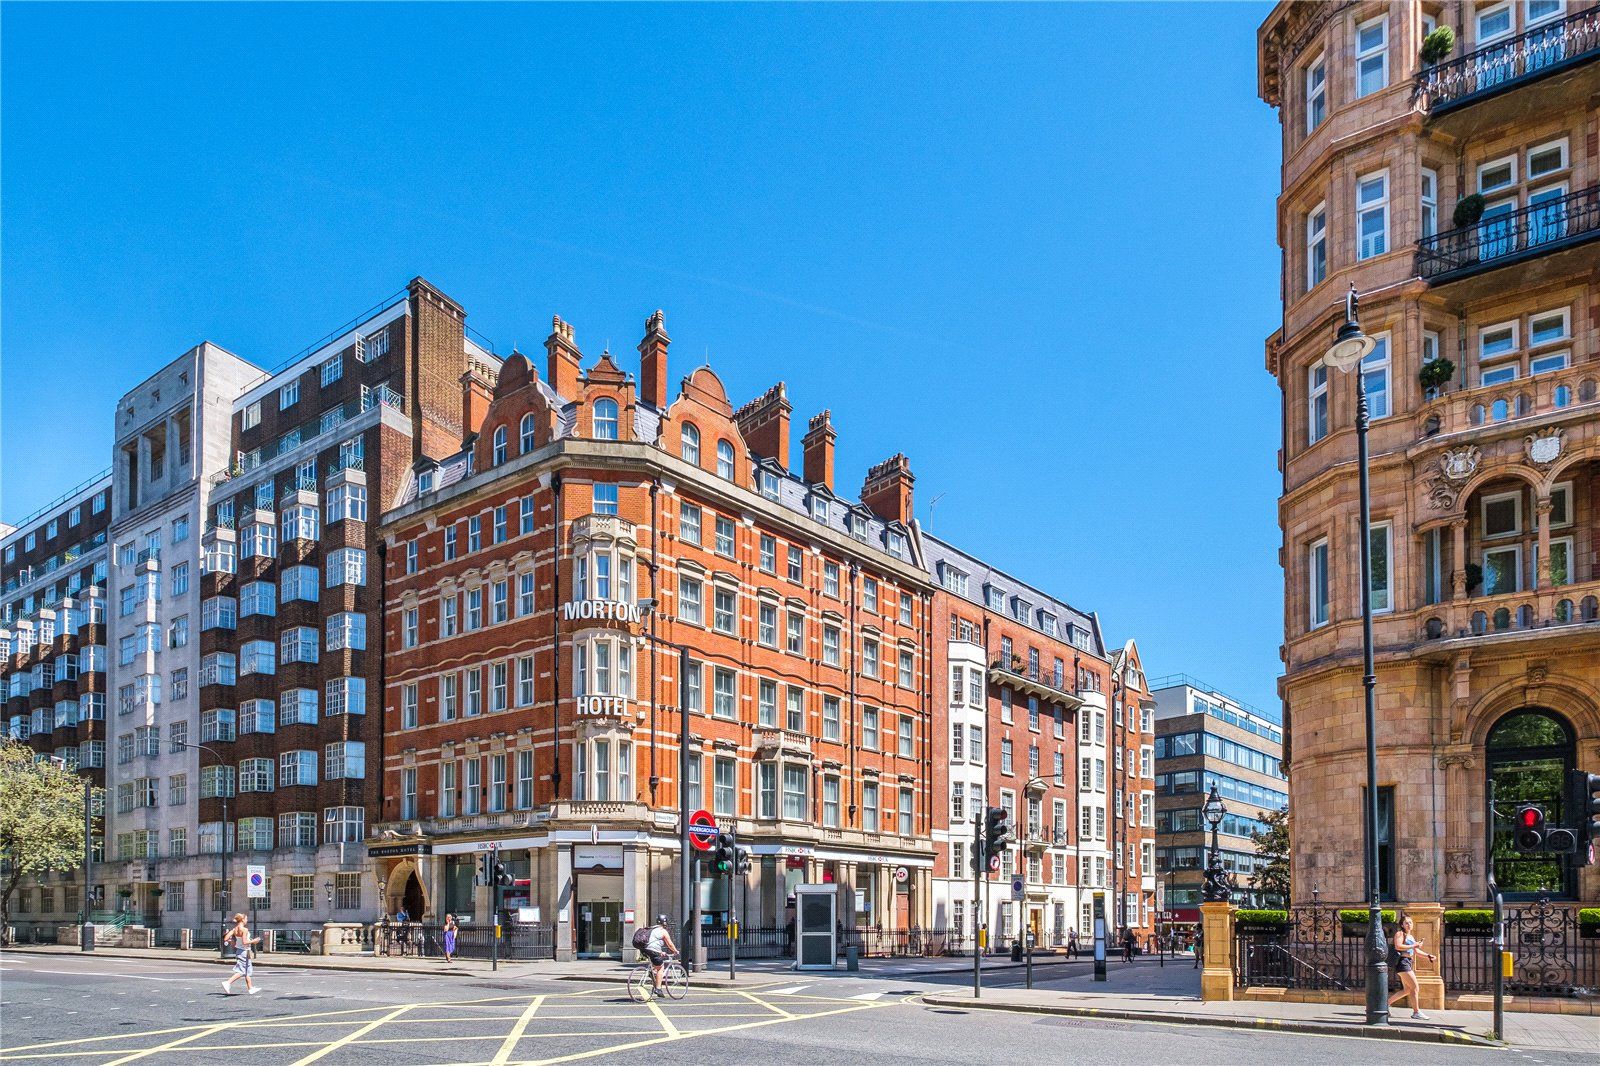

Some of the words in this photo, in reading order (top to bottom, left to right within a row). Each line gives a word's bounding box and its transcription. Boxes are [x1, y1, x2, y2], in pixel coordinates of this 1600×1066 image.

[564, 600, 641, 623] MORTON
[576, 696, 632, 716] HOTEL
[477, 842, 489, 850] HSBC
